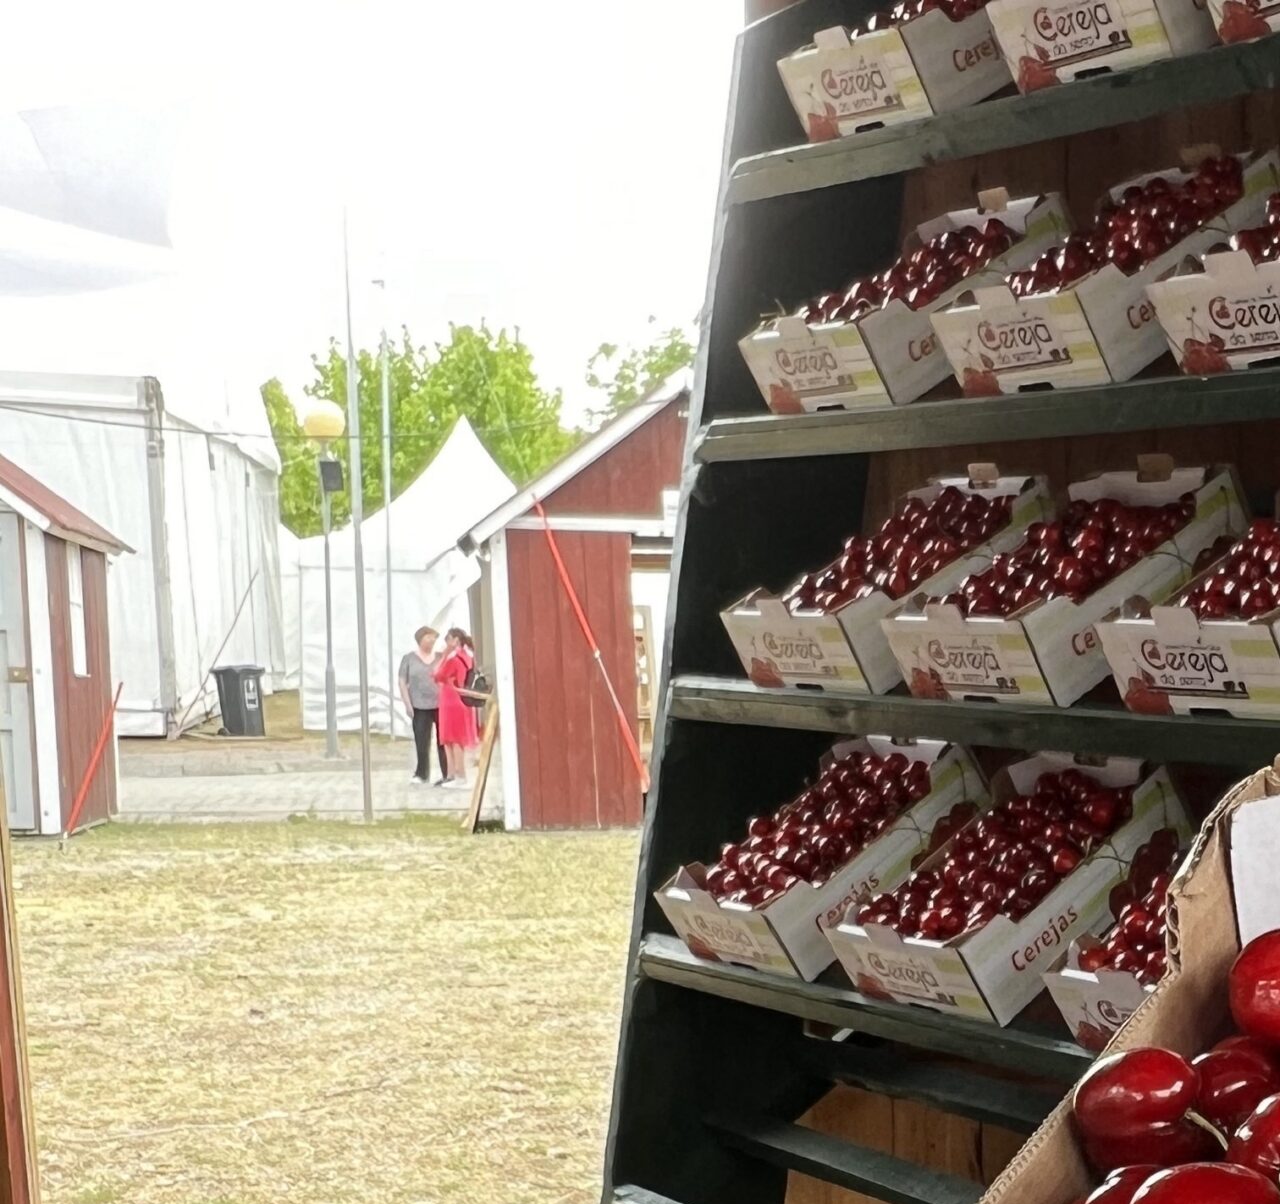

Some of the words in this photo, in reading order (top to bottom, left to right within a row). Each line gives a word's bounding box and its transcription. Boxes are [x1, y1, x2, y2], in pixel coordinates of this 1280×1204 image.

[1033, 3, 1112, 41] Cereja
[821, 68, 887, 99] Cereja
[1140, 638, 1228, 684] Cereja
[1012, 906, 1079, 972] Cerejas
